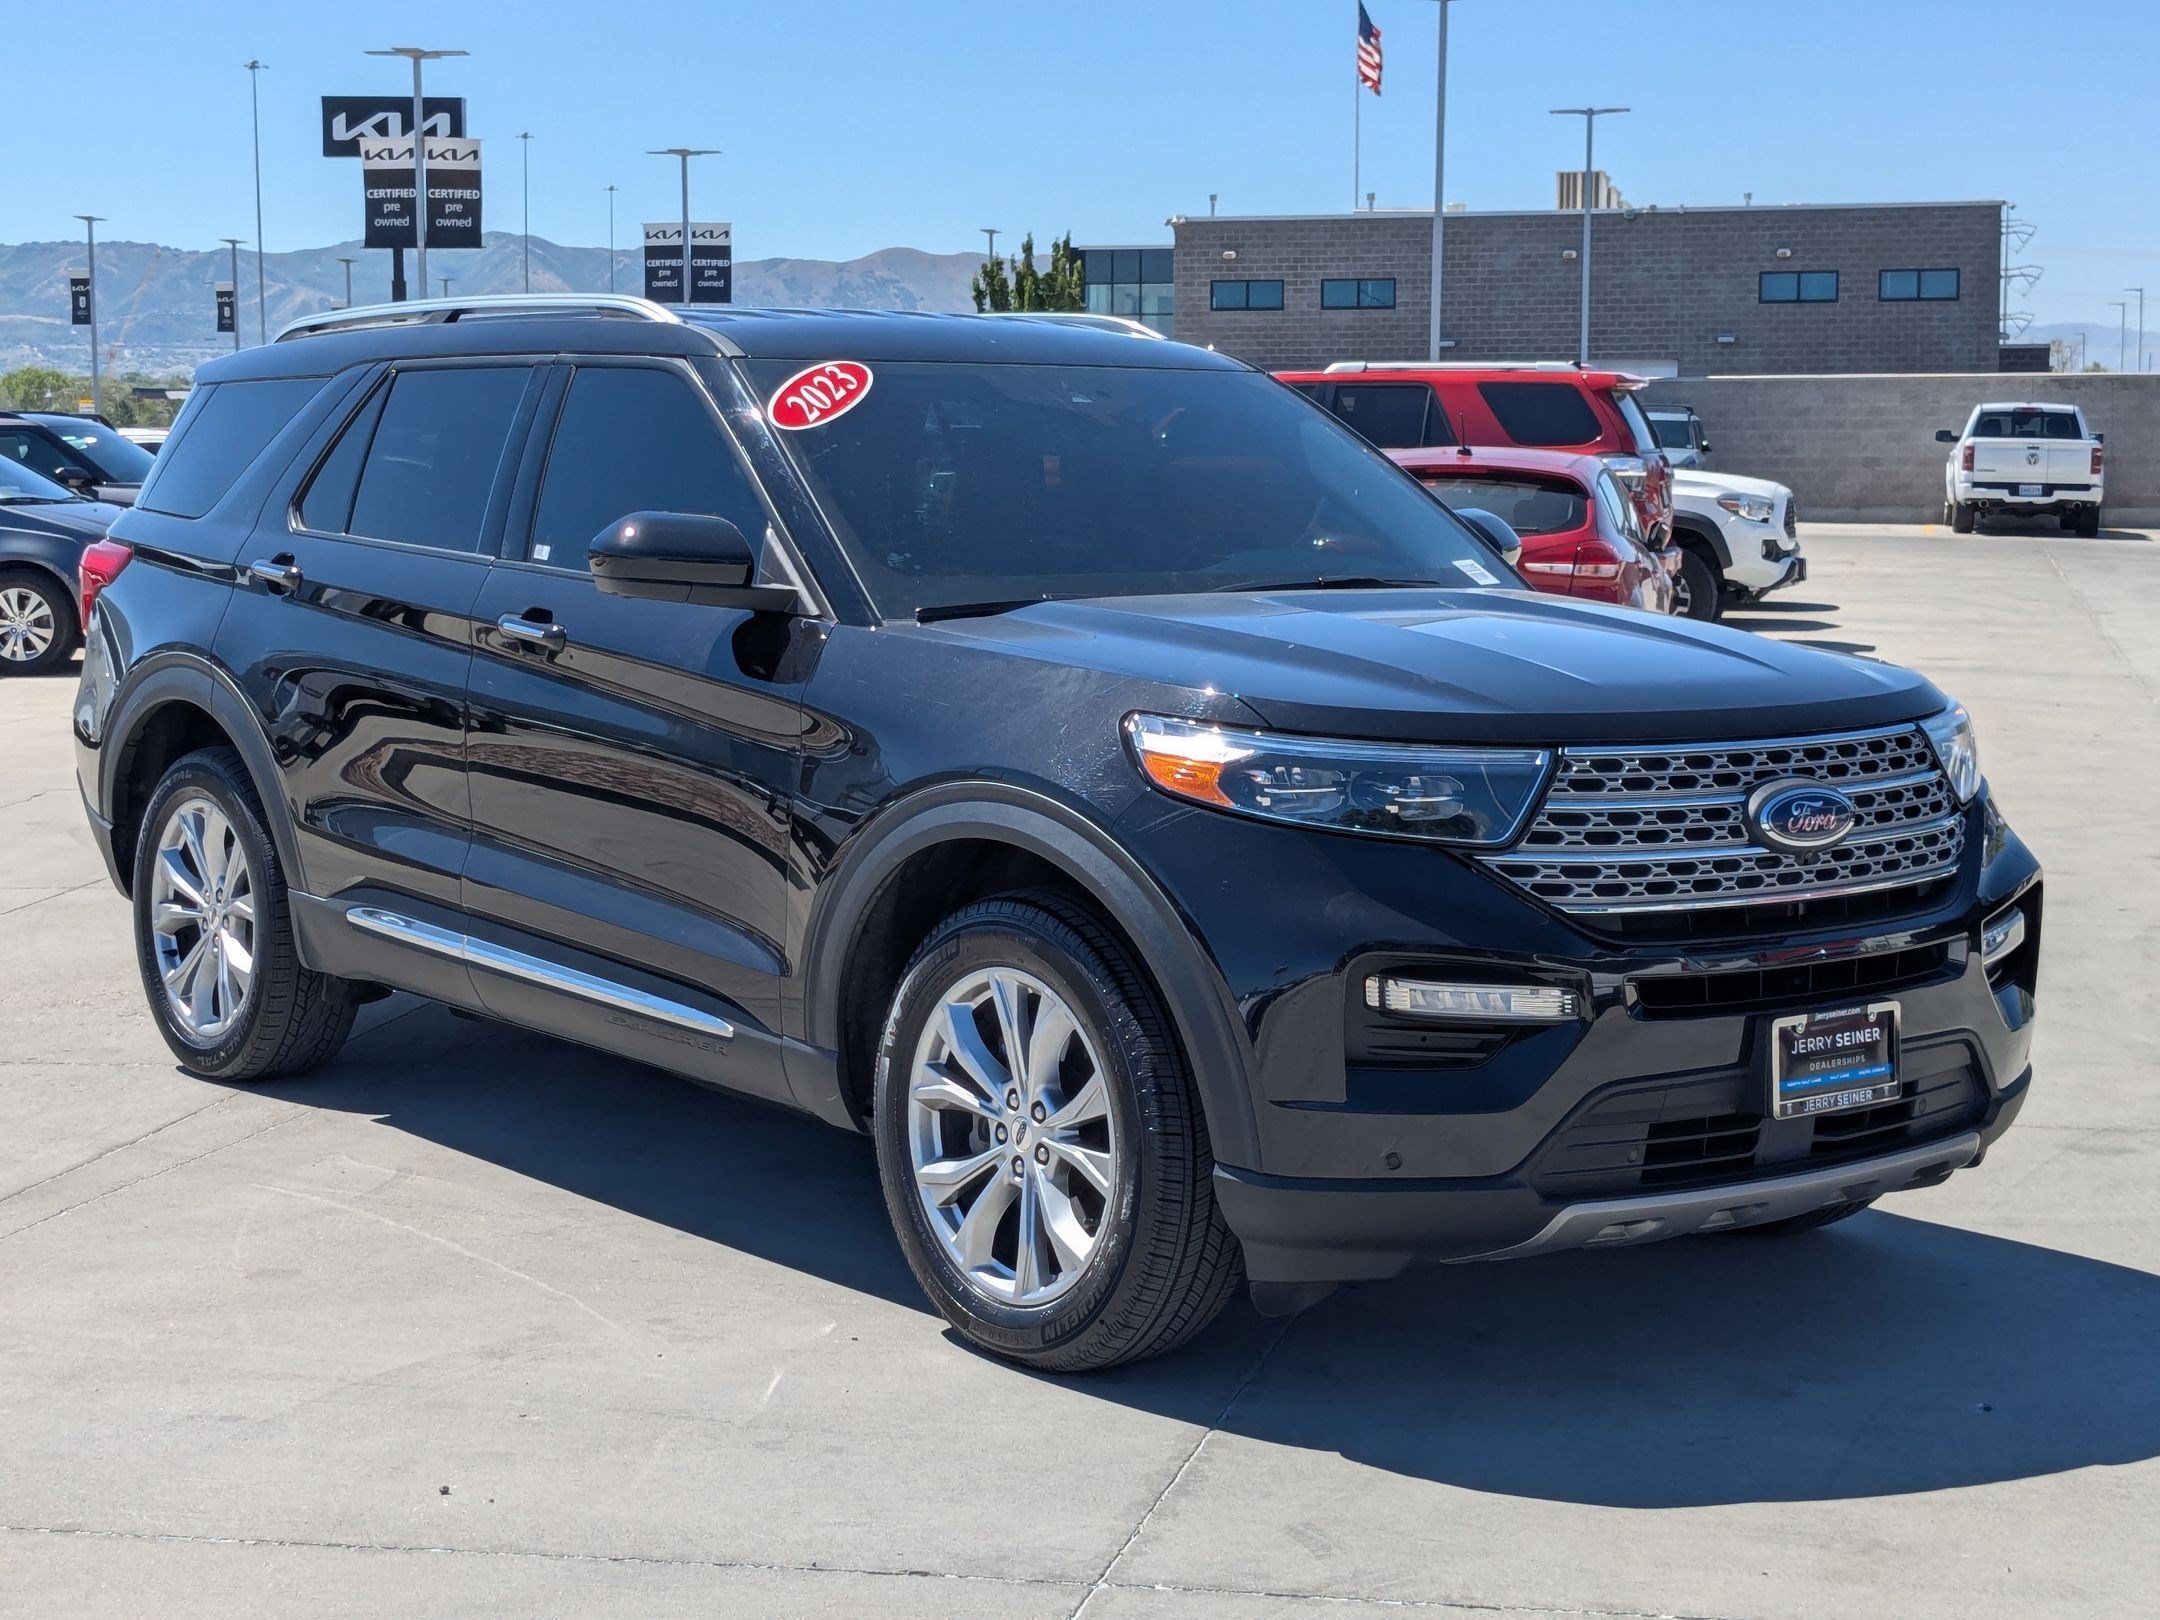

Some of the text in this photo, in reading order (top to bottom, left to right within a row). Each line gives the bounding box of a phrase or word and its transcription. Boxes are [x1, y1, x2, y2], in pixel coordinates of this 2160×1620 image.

[364, 147, 415, 161] KIA
[428, 148, 479, 162] KIA
[366, 188, 417, 199] CERTIFIED
[428, 188, 480, 200] CERTIFIED
[383, 203, 401, 213] pre
[445, 203, 463, 213] pre
[374, 216, 410, 227] owned
[435, 217, 472, 228] owned
[646, 259, 683, 268] CERTIFIED
[691, 259, 730, 268] CERTIFIED
[658, 270, 671, 279] pre
[704, 269, 718, 278] pre
[651, 279, 678, 288] owned
[697, 279, 724, 288] owned
[786, 366, 858, 422] 2023
[1788, 800, 1837, 833] Ford
[1791, 1027, 1881, 1054] JERRY SEINER
[1809, 1055, 1866, 1071] DEALERSHIPS
[1803, 1089, 1873, 1112] JERRY SEINER
